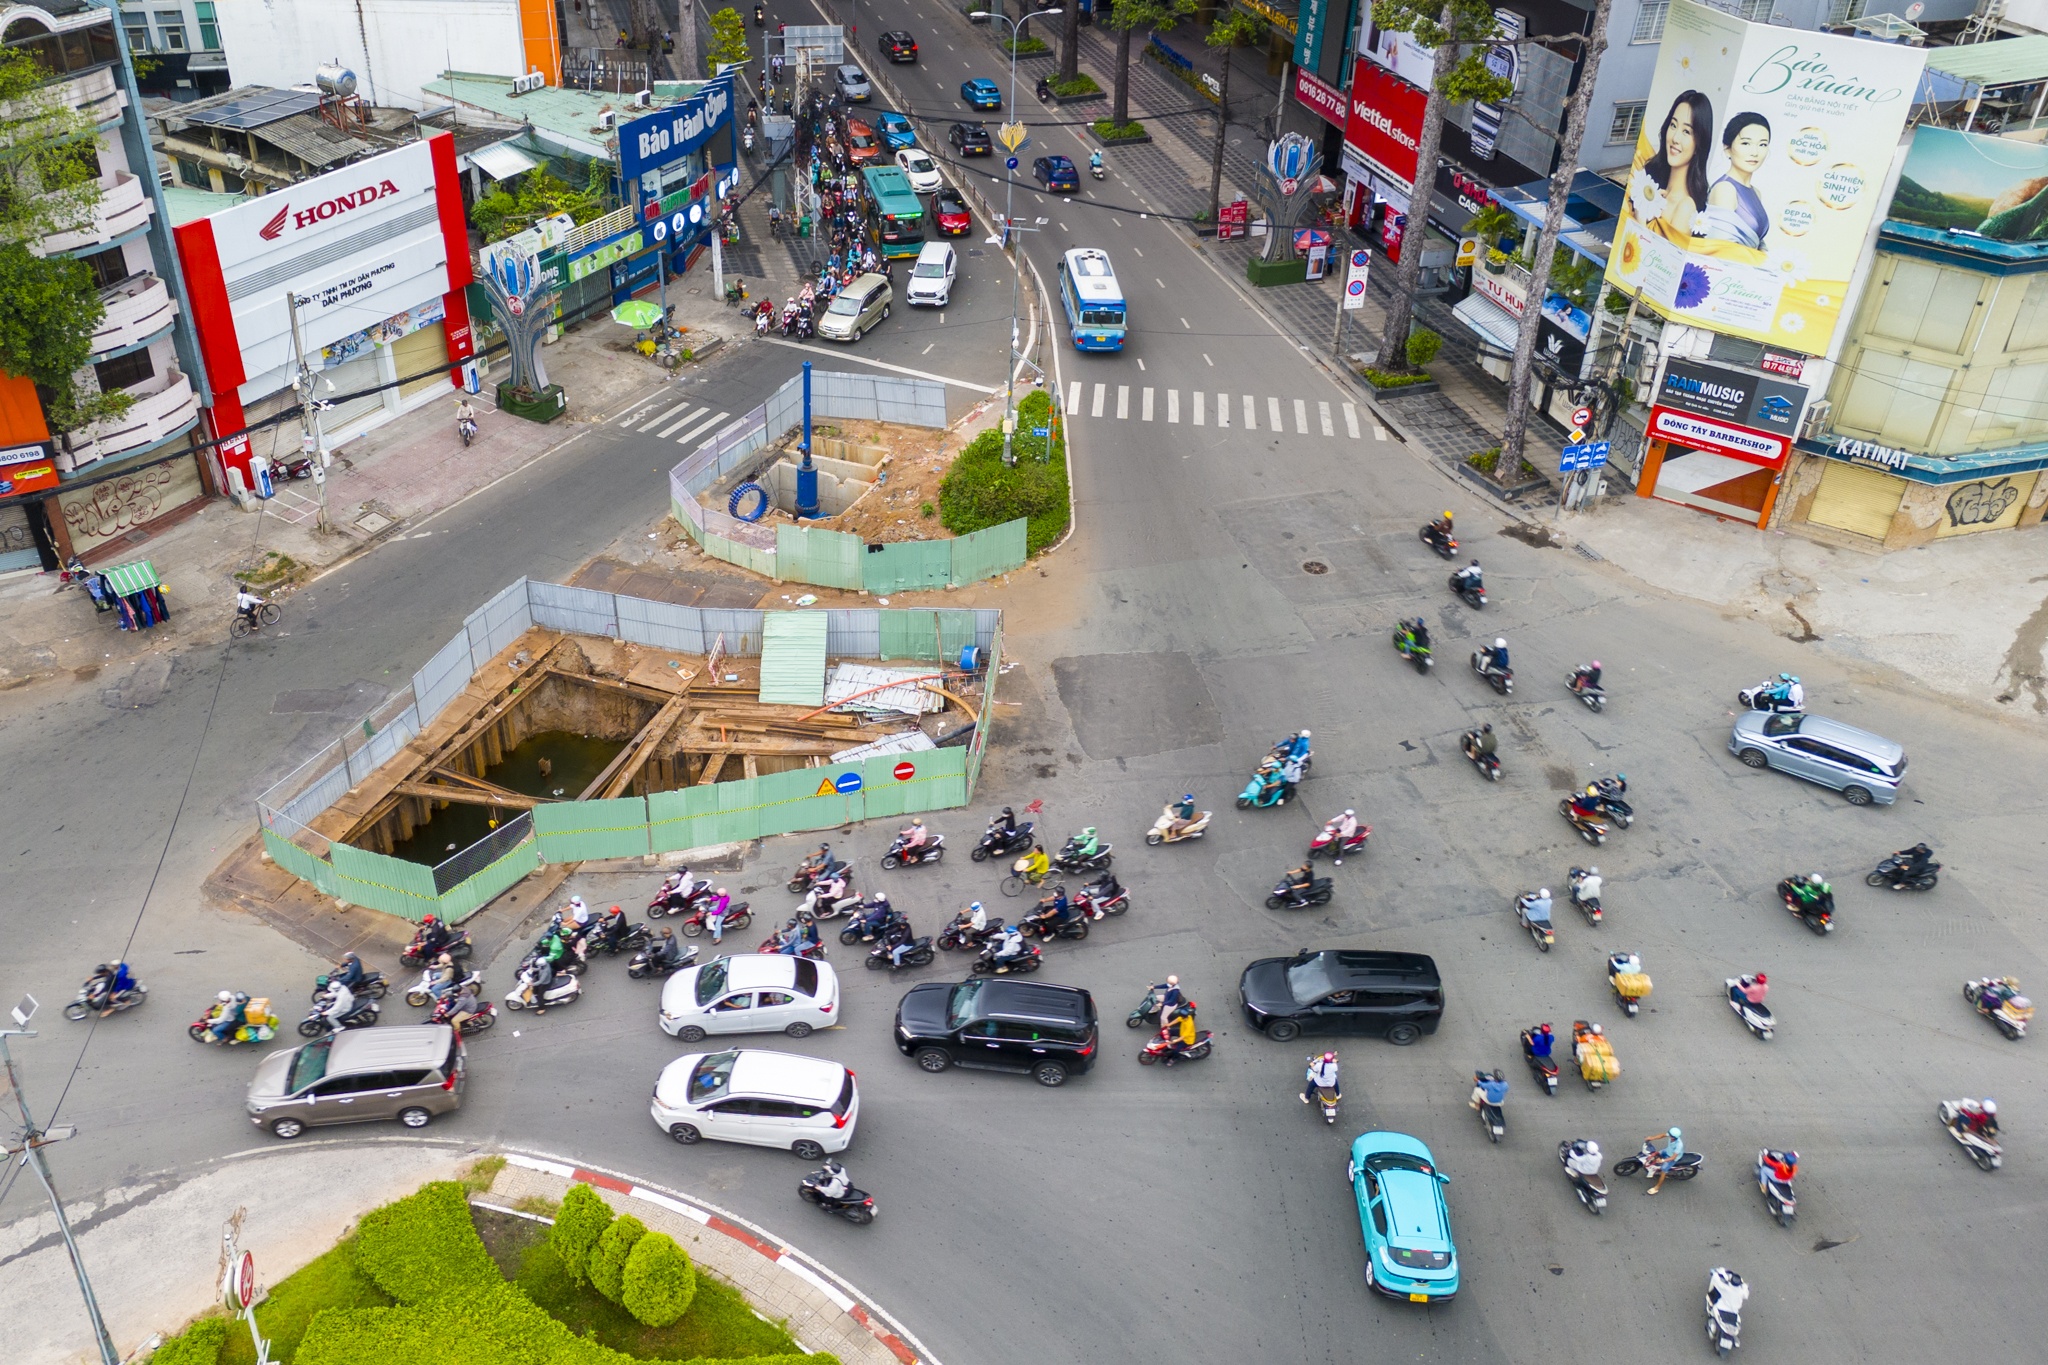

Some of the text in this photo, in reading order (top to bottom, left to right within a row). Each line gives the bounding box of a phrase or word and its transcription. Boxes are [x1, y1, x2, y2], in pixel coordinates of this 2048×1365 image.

[1742, 45, 1828, 94] Bảo
[1299, 79, 1346, 118] 0916 26 77 88
[1796, 74, 1902, 111] xuân
[1827, 100, 1841, 108] NỘI
[1842, 102, 1859, 111] TIẾT
[638, 125, 670, 159] Bảo
[673, 107, 704, 145] Hành
[1790, 138, 1808, 147] BỐC
[1823, 182, 1859, 194] SINH LÝ
[1824, 171, 1864, 185] CẢI THIỆN
[293, 179, 400, 230] HONDA
[1830, 193, 1846, 203] NỮ
[1784, 209, 1812, 219] ĐẸP DA
[540, 266, 559, 283] ONG
[294, 296, 311, 308] CÔNG
[312, 293, 321, 301] TY
[322, 285, 338, 297] TNHH
[339, 282, 348, 290] TM
[348, 278, 357, 286] DV
[340, 280, 373, 300] PHƯƠNG
[1663, 418, 1688, 431] ĐÔNG
[1691, 425, 1708, 435] TÂY
[1708, 430, 1773, 452] BARBERSHOP
[0, 450, 40, 463] 800 6198
[1835, 436, 1913, 471] KATINAT
